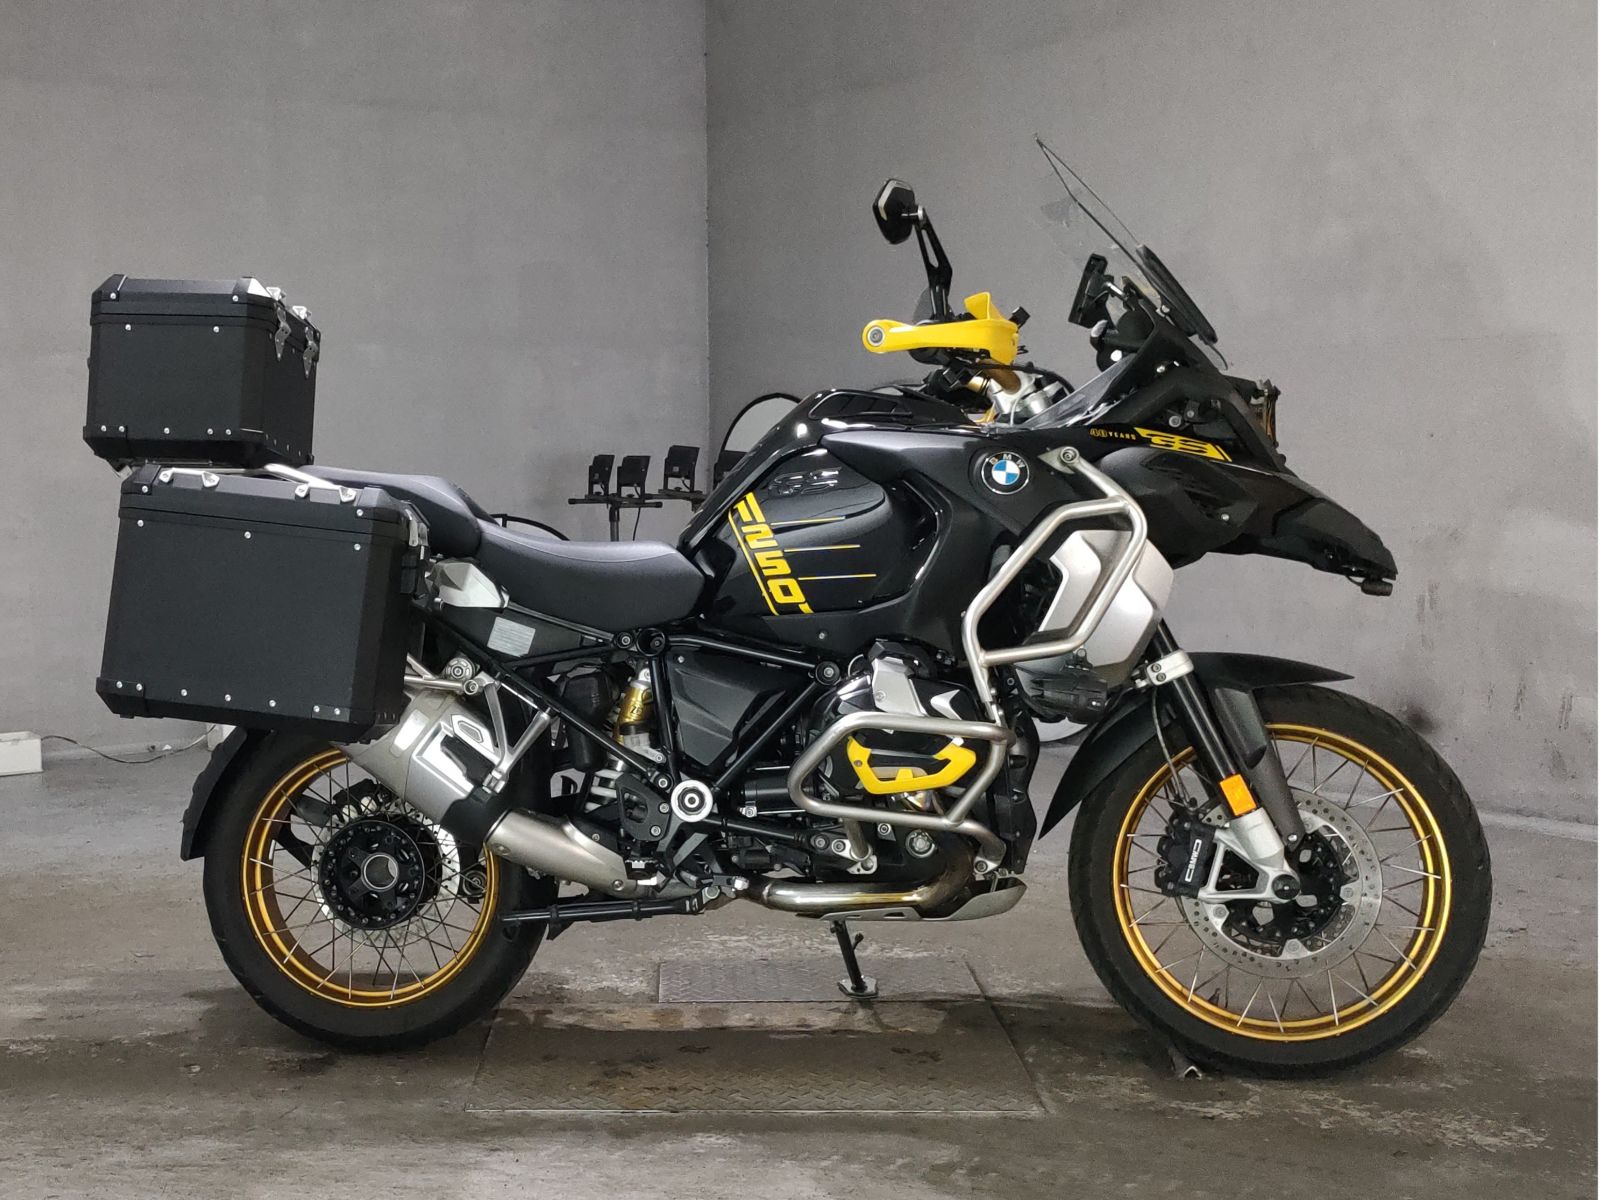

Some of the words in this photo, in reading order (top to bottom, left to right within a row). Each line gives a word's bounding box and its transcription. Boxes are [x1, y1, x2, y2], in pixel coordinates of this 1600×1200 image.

[1108, 431, 1137, 440] YEARS
[989, 453, 1025, 468] BMW
[734, 498, 806, 603] 1250
